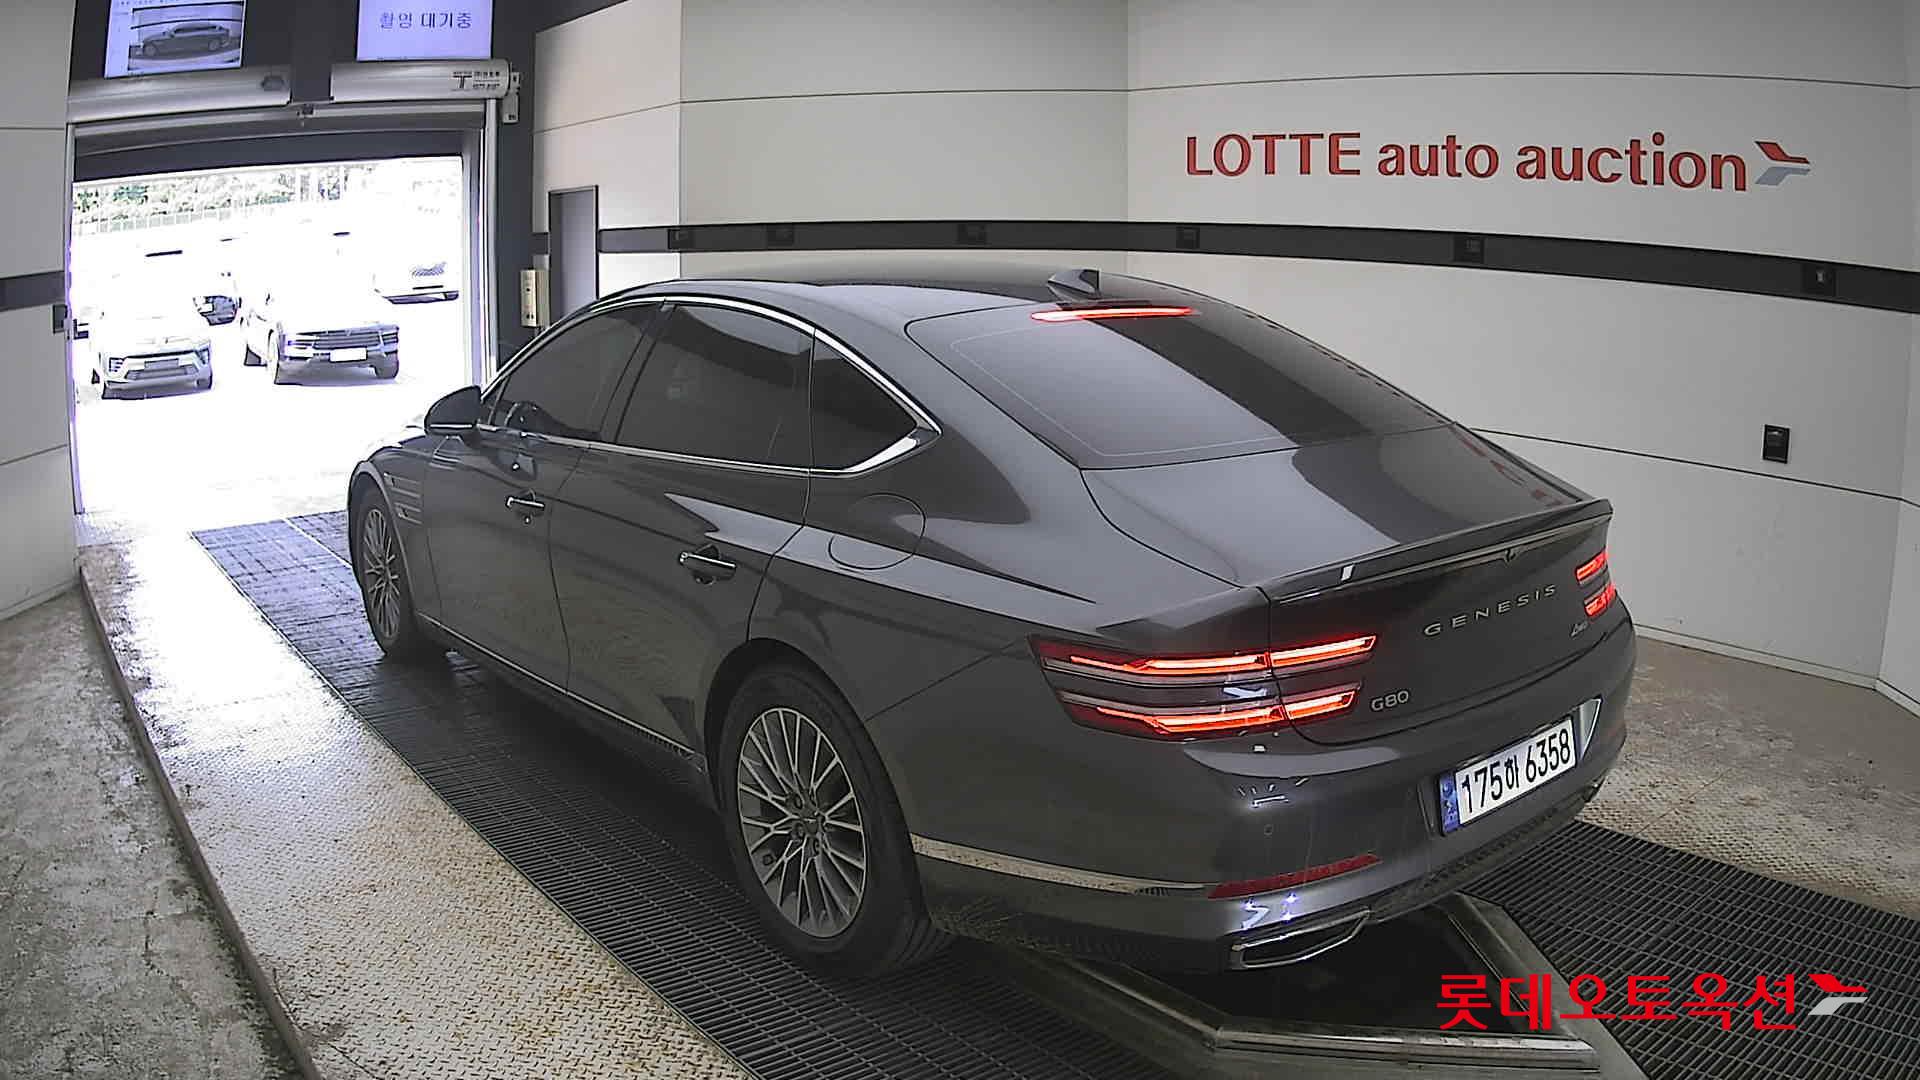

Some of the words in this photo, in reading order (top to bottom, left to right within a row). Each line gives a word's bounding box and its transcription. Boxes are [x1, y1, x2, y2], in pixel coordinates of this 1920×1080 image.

[421, 12, 471, 28] 대기중
[1187, 132, 1361, 177] LOTTE
[1377, 135, 1499, 178] auto
[1515, 132, 1747, 192] auction
[1424, 584, 1556, 636] GENESIS
[1371, 690, 1409, 711] G80
[1461, 754, 1520, 813] 175하
[1525, 727, 1572, 784] 6358
